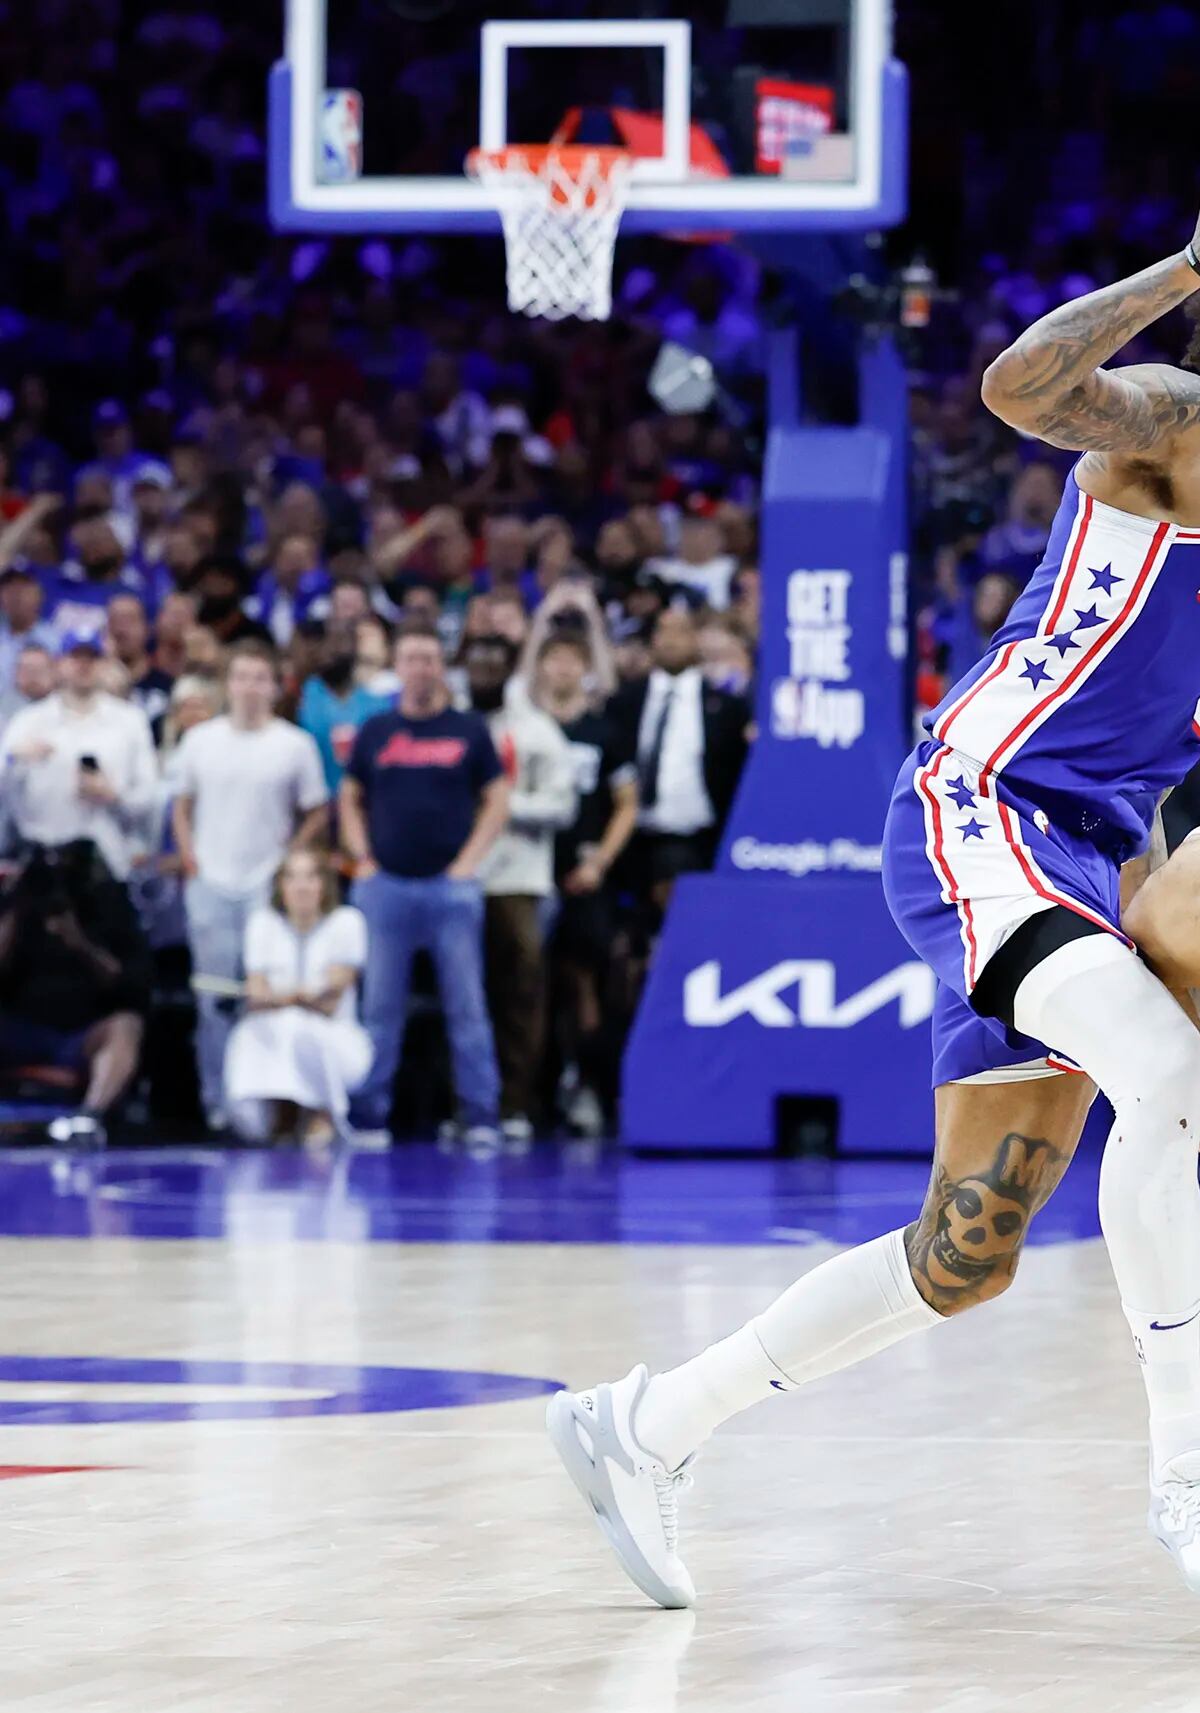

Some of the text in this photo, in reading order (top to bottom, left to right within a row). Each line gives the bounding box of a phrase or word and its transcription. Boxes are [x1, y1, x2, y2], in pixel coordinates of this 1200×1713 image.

[787, 570, 852, 624] GET
[787, 624, 852, 682] THE
[731, 836, 827, 877] Google
